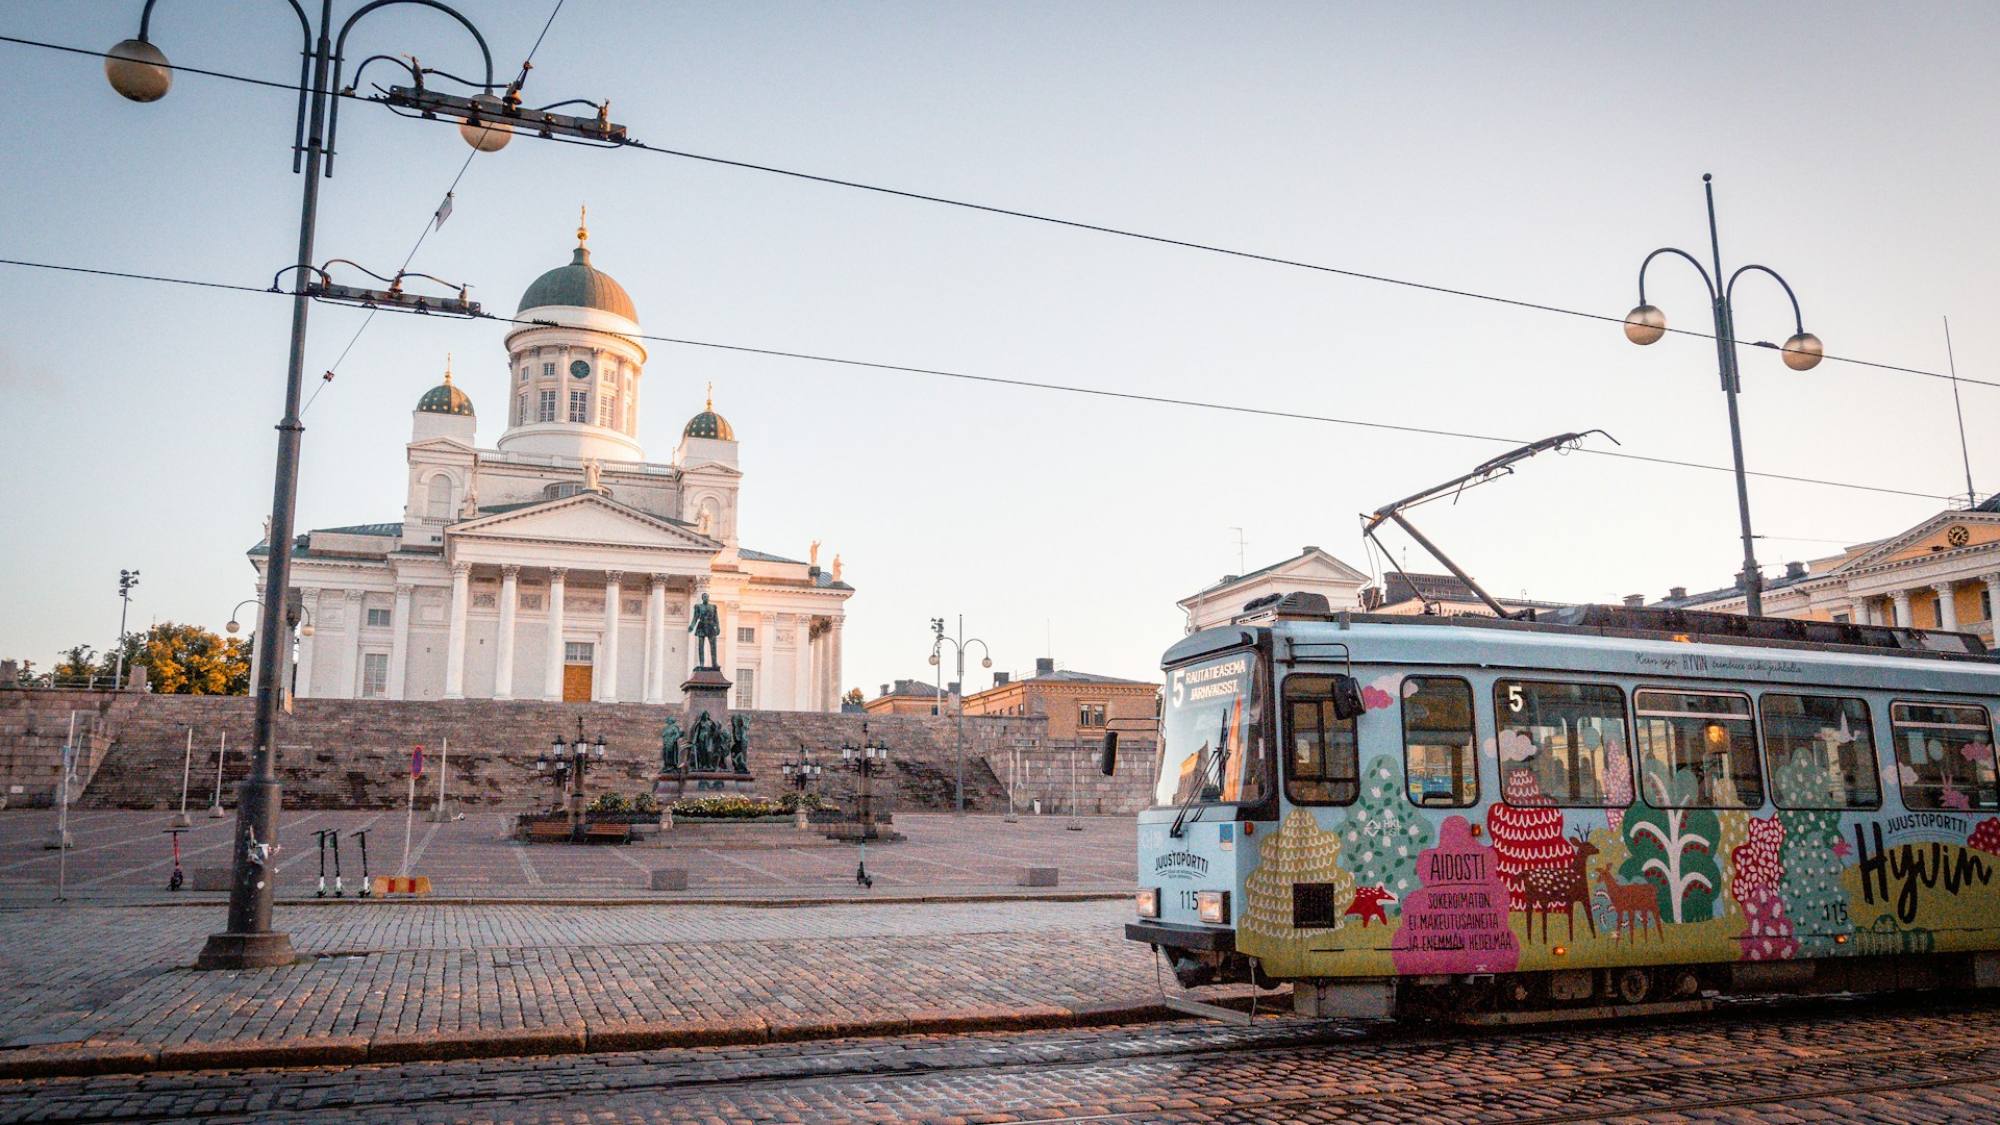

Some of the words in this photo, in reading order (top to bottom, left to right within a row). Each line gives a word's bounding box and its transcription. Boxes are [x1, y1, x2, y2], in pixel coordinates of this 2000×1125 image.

[1186, 659, 1246, 684] RAUTATIEASEMA
[1681, 654, 1708, 672] HYVIN
[1173, 670, 1185, 707] 5
[1508, 685, 1524, 713] 5
[1887, 814, 1968, 834] JUUSTOPORTTI
[1155, 852, 1209, 873] JUUSTOPORTTI
[1430, 853, 1485, 880] AIDOSTI
[1854, 821, 1992, 924] Hyvin
[1180, 890, 1199, 910] 115
[1408, 914, 1417, 931] EI
[1420, 912, 1499, 931] MAKEUTUSAINEITA
[1823, 903, 1848, 925] 115
[1407, 936, 1418, 951] JA
